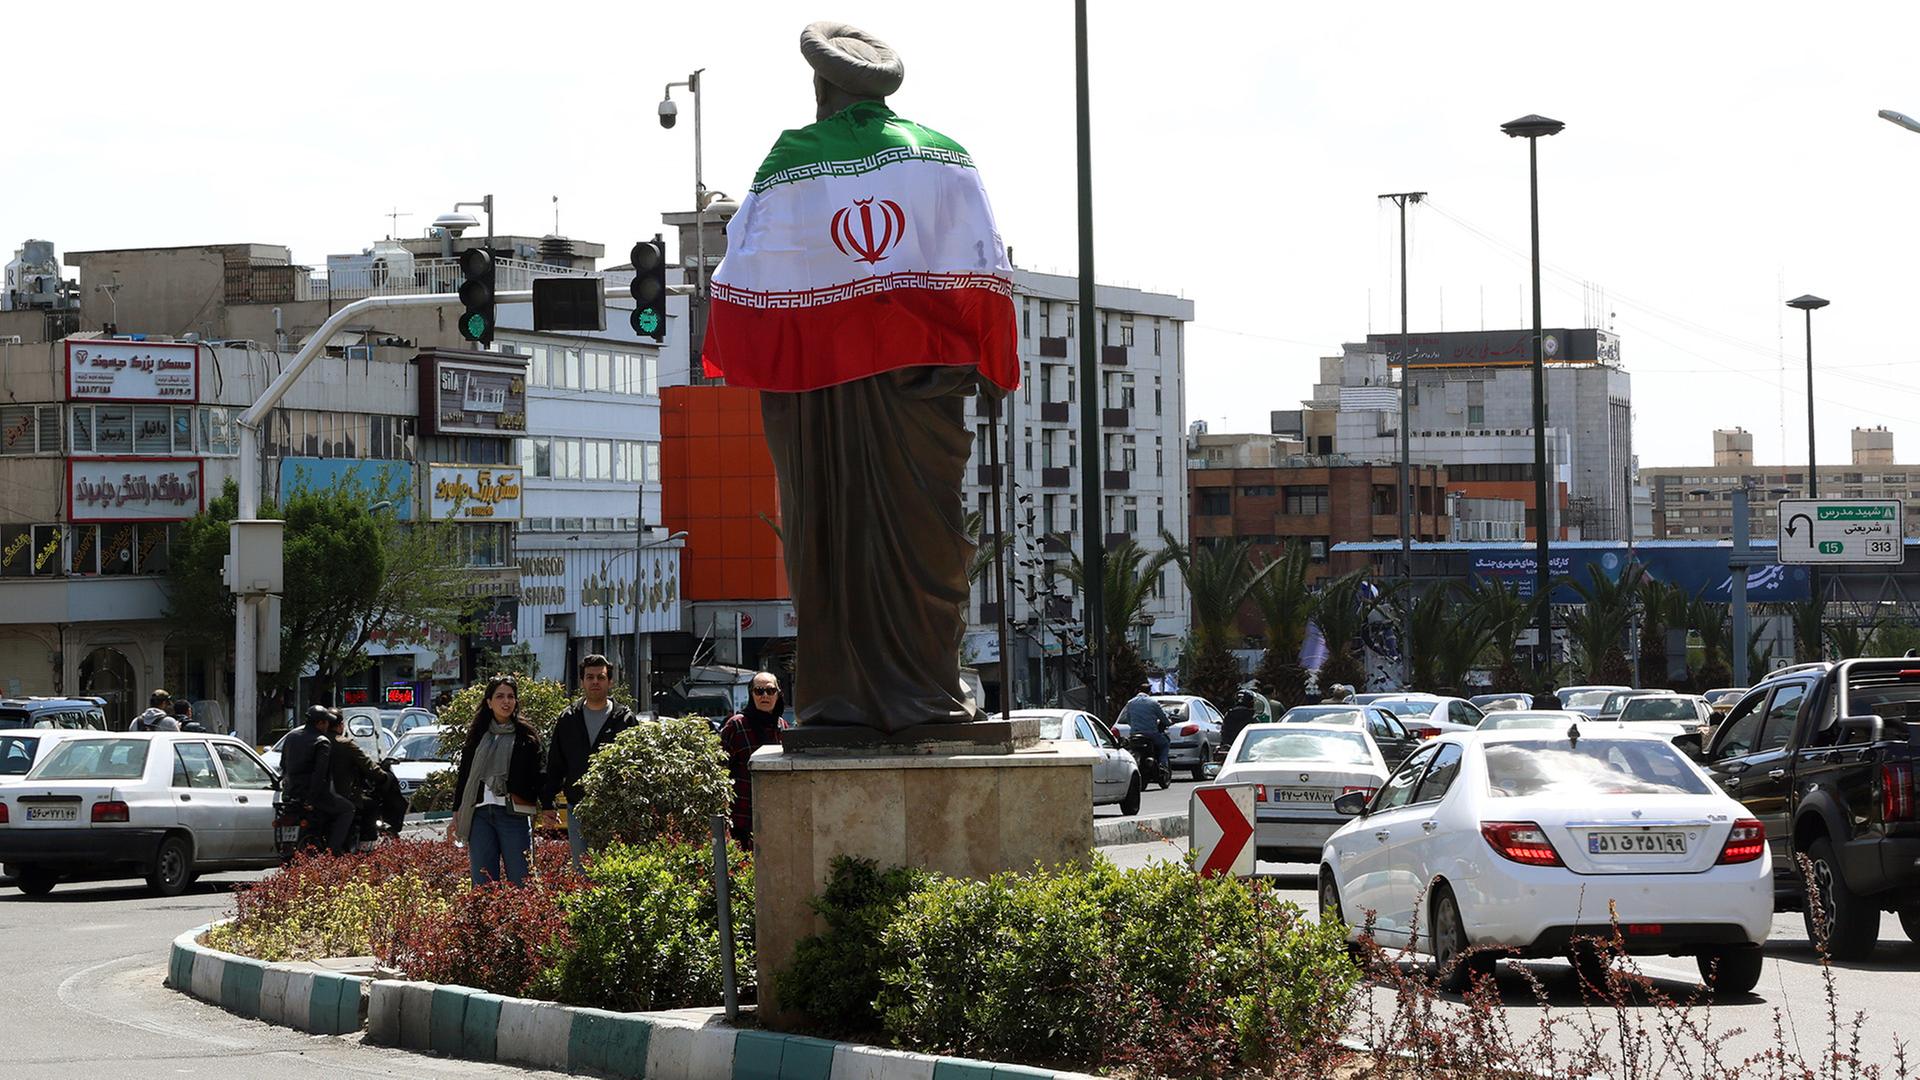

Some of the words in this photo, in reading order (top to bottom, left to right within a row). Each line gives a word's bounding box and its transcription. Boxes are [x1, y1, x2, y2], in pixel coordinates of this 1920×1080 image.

[130, 354, 155, 374] بزرگ
[157, 358, 191, 371] مسکن
[1819, 508, 1853, 520] مدرس
[1855, 507, 1881, 518] شهید
[1844, 521, 1882, 535] شریعتی
[1824, 542, 1839, 553] 15
[1871, 541, 1892, 553] 313
[1665, 838, 1685, 852] ۹۹
